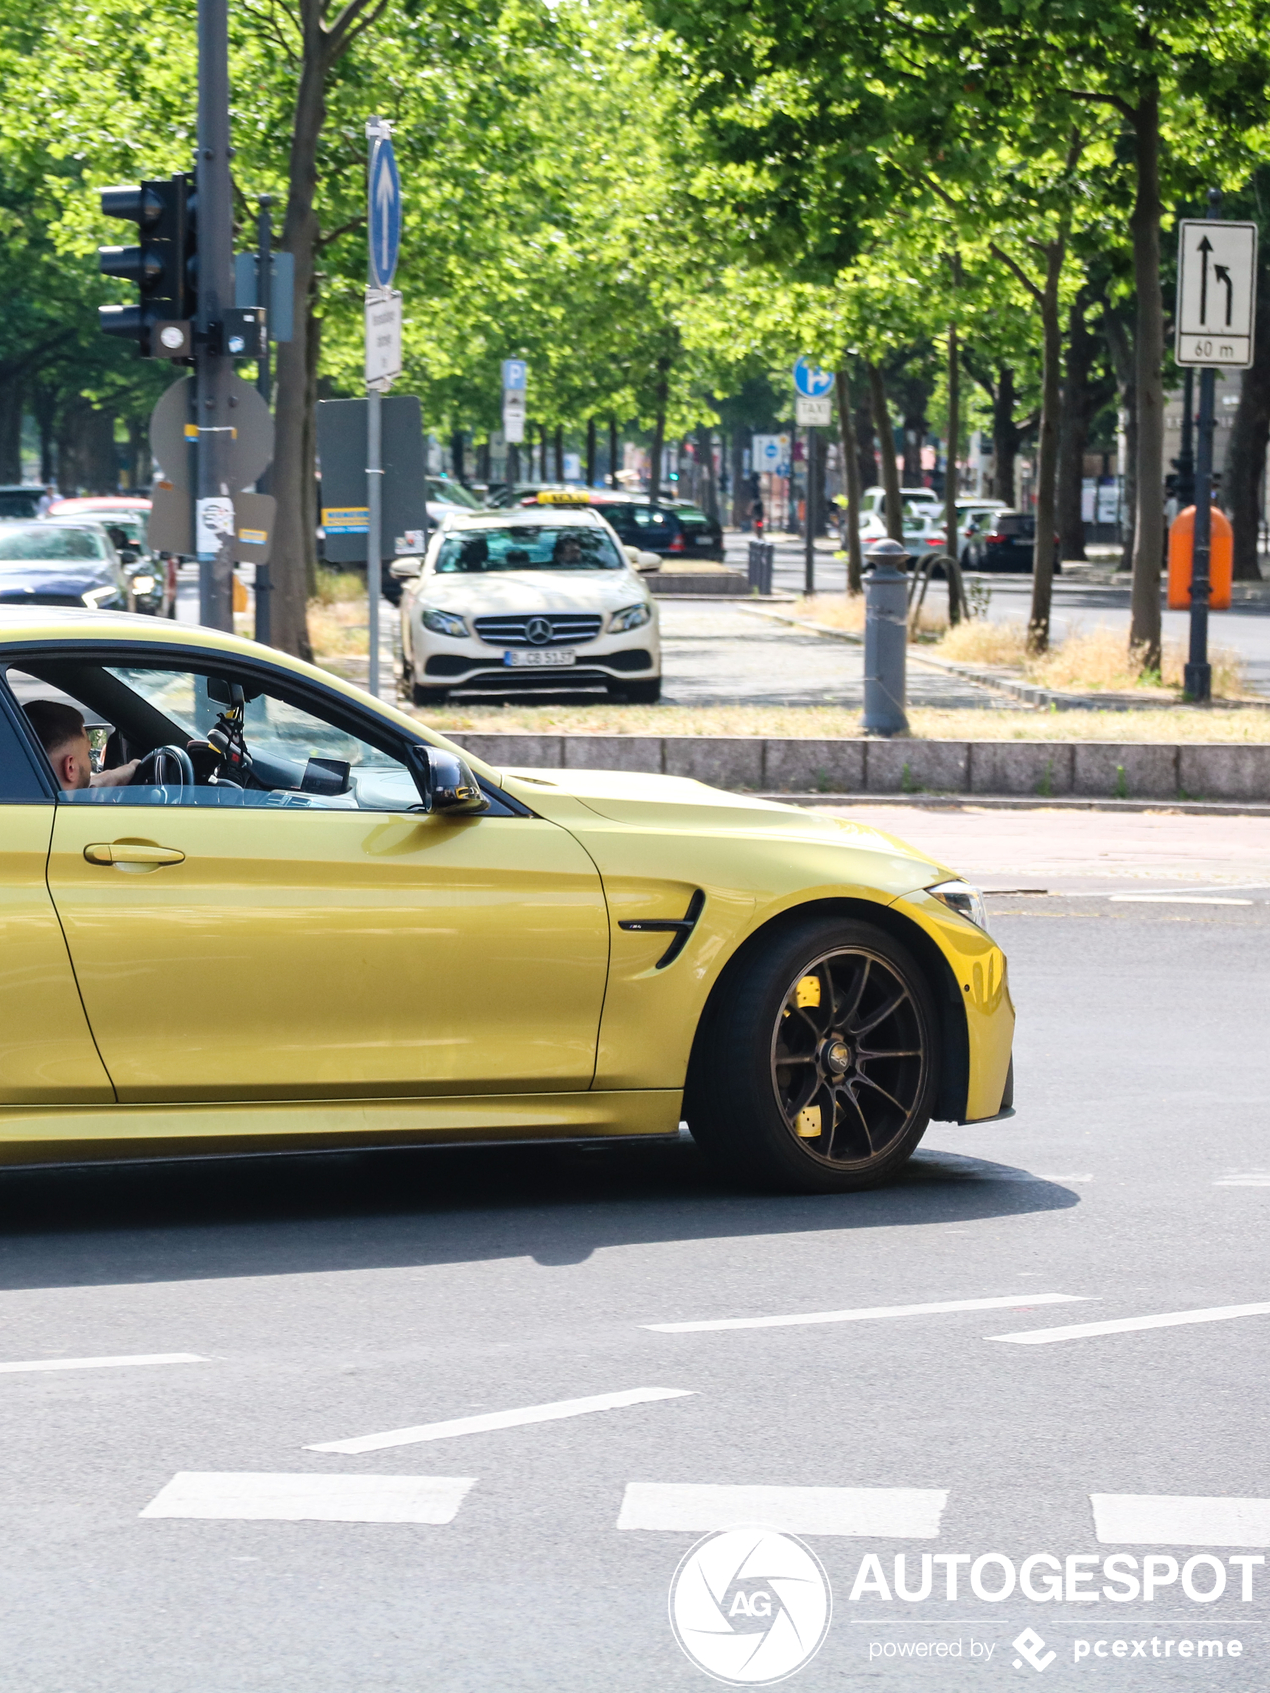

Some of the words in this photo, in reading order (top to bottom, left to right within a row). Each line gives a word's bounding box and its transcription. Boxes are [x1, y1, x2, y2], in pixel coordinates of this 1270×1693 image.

[1195, 340, 1212, 357] 60
[1219, 345, 1233, 358] m
[509, 364, 521, 387] P
